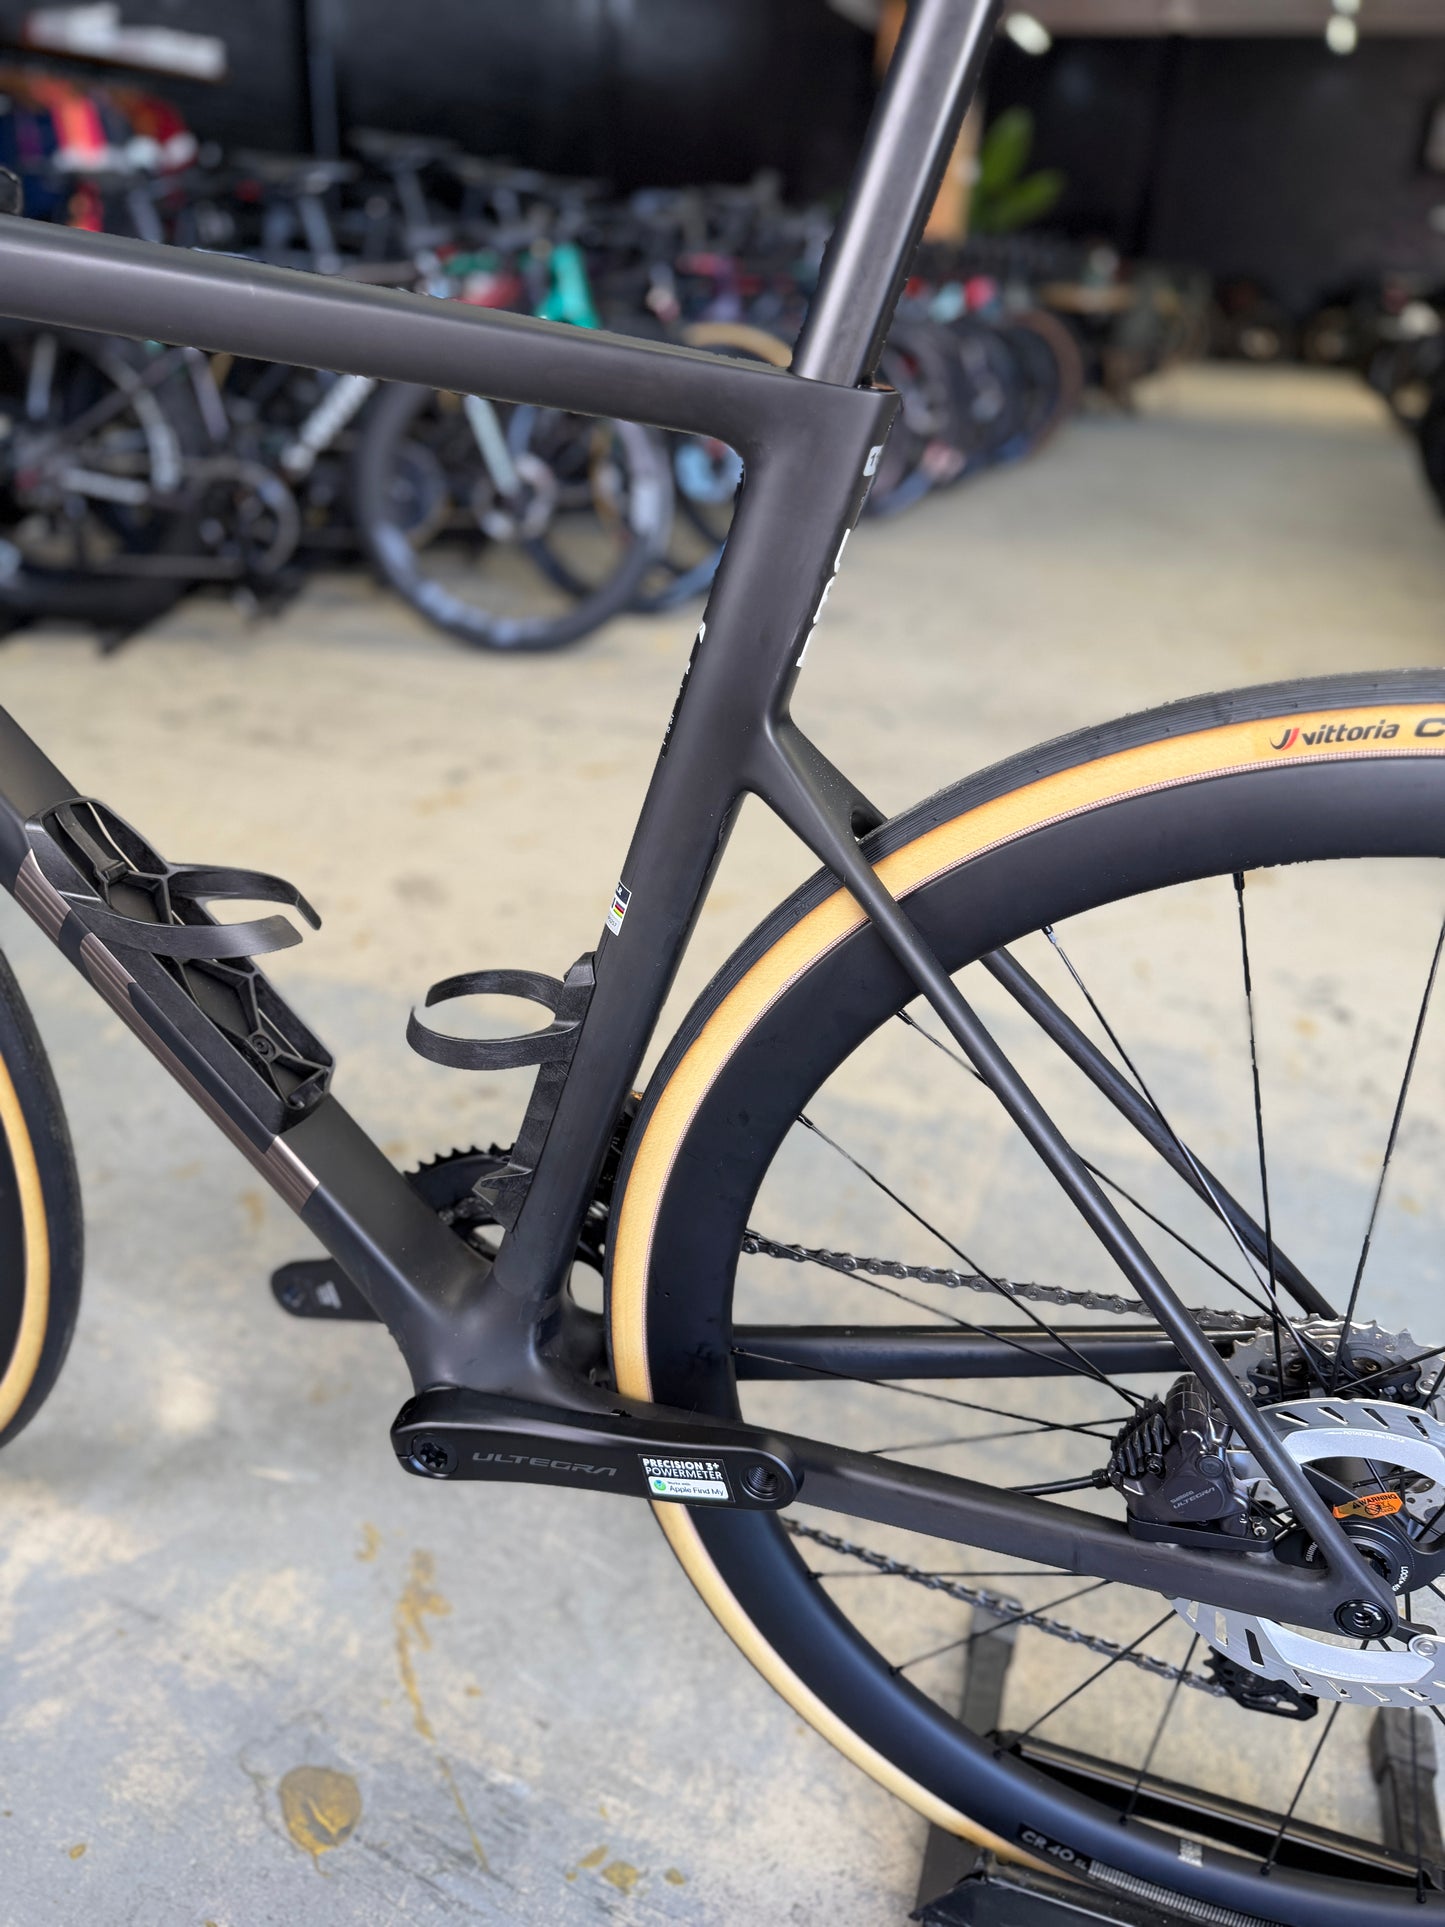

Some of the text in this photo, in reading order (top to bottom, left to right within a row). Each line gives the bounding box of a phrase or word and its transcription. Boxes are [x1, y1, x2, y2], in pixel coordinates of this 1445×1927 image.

[1302, 719, 1400, 746] vittoria
[471, 1452, 618, 1477] ULTEGRA
[642, 1458, 720, 1471] PRECISION 3+
[645, 1466, 723, 1480] POWERMETER
[669, 1485, 724, 1496] Apple Find My
[1173, 1487, 1215, 1509] ULTEGRA
[1358, 1493, 1398, 1506] WARNING
[1399, 1565, 1409, 1582] LOCK
[1047, 1844, 1075, 1861] 40
